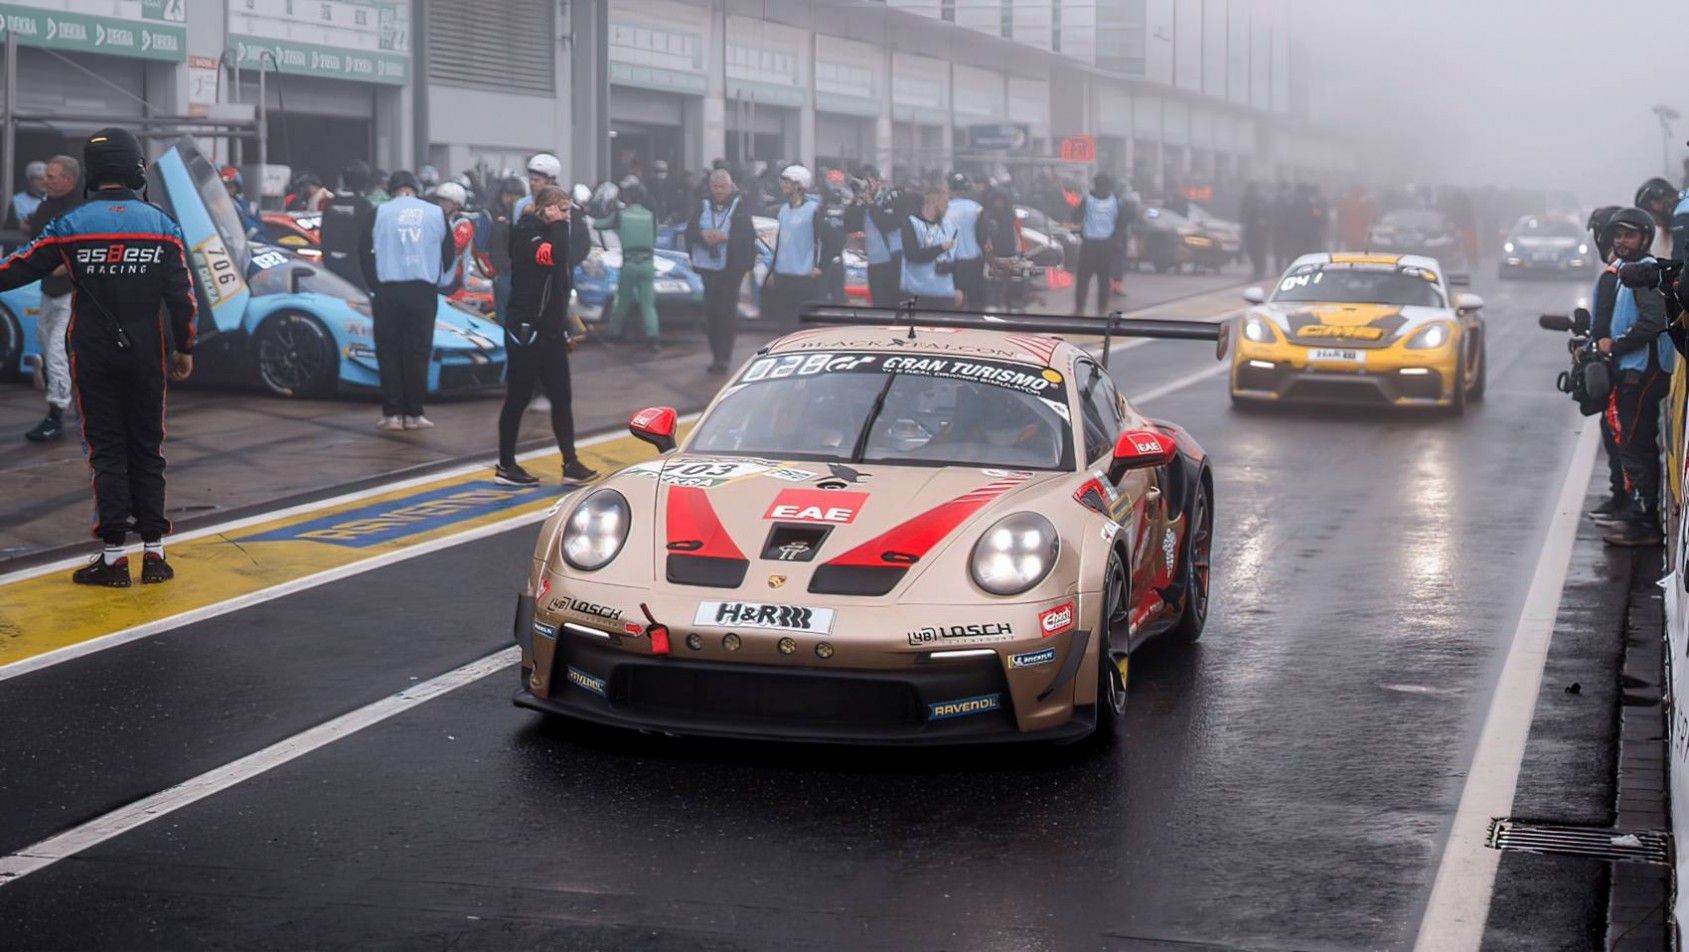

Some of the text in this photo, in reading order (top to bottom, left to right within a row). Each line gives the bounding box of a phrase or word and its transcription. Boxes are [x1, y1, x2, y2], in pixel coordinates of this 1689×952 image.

[398, 227, 422, 245] TV
[86, 264, 148, 275] RACING
[207, 247, 236, 285] 706
[913, 342, 1014, 357] FALCON
[743, 354, 834, 382] 028
[882, 357, 948, 371] GRAN
[950, 362, 1050, 390] TURISMO
[1137, 441, 1161, 453] EAE
[771, 505, 853, 522] EAE
[571, 599, 623, 621] LOSCH
[715, 602, 777, 625] H&R
[939, 623, 1013, 638] LOSCH
[934, 697, 996, 716] RAVENOL
